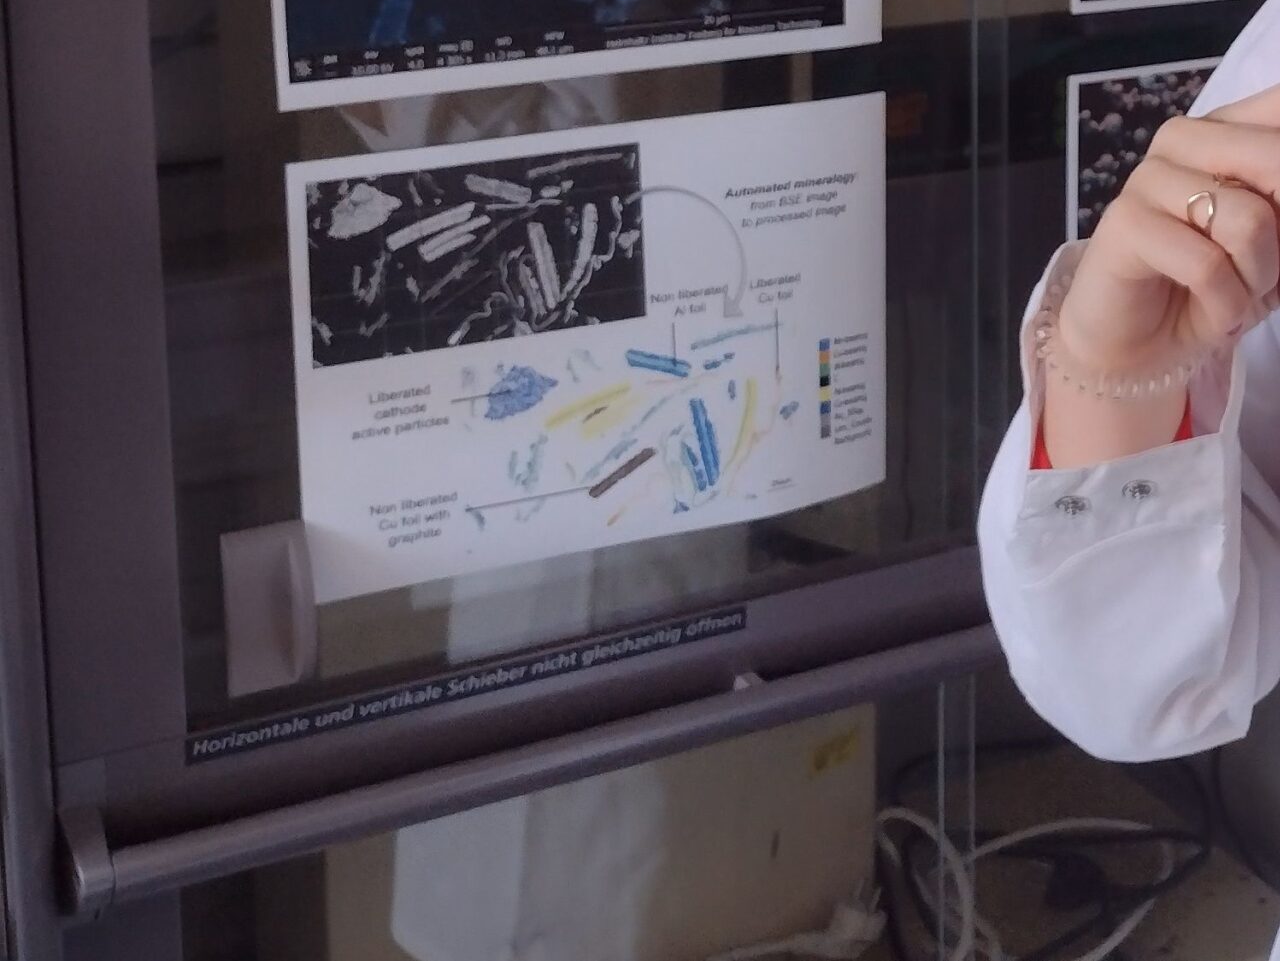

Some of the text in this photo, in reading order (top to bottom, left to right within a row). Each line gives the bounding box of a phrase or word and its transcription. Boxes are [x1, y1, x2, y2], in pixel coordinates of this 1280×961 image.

[725, 172, 856, 199] Automated mineralogy
[750, 199, 777, 211] from
[806, 191, 838, 203] image
[755, 208, 813, 227] processed
[815, 203, 847, 218] image
[750, 272, 801, 290] Liberated
[650, 284, 729, 304] Non liberated
[368, 384, 431, 405] Liberated
[374, 403, 427, 420] cathode
[351, 416, 449, 441] active particles
[369, 491, 458, 517] Non liberated
[424, 509, 451, 523] with
[388, 528, 442, 548] graphite
[193, 717, 310, 755] Horizontale
[315, 703, 355, 728] und
[359, 685, 444, 717] vertikale
[447, 666, 529, 697] Schieber
[531, 651, 578, 676] nicht
[581, 627, 683, 667] gleichzeitig
